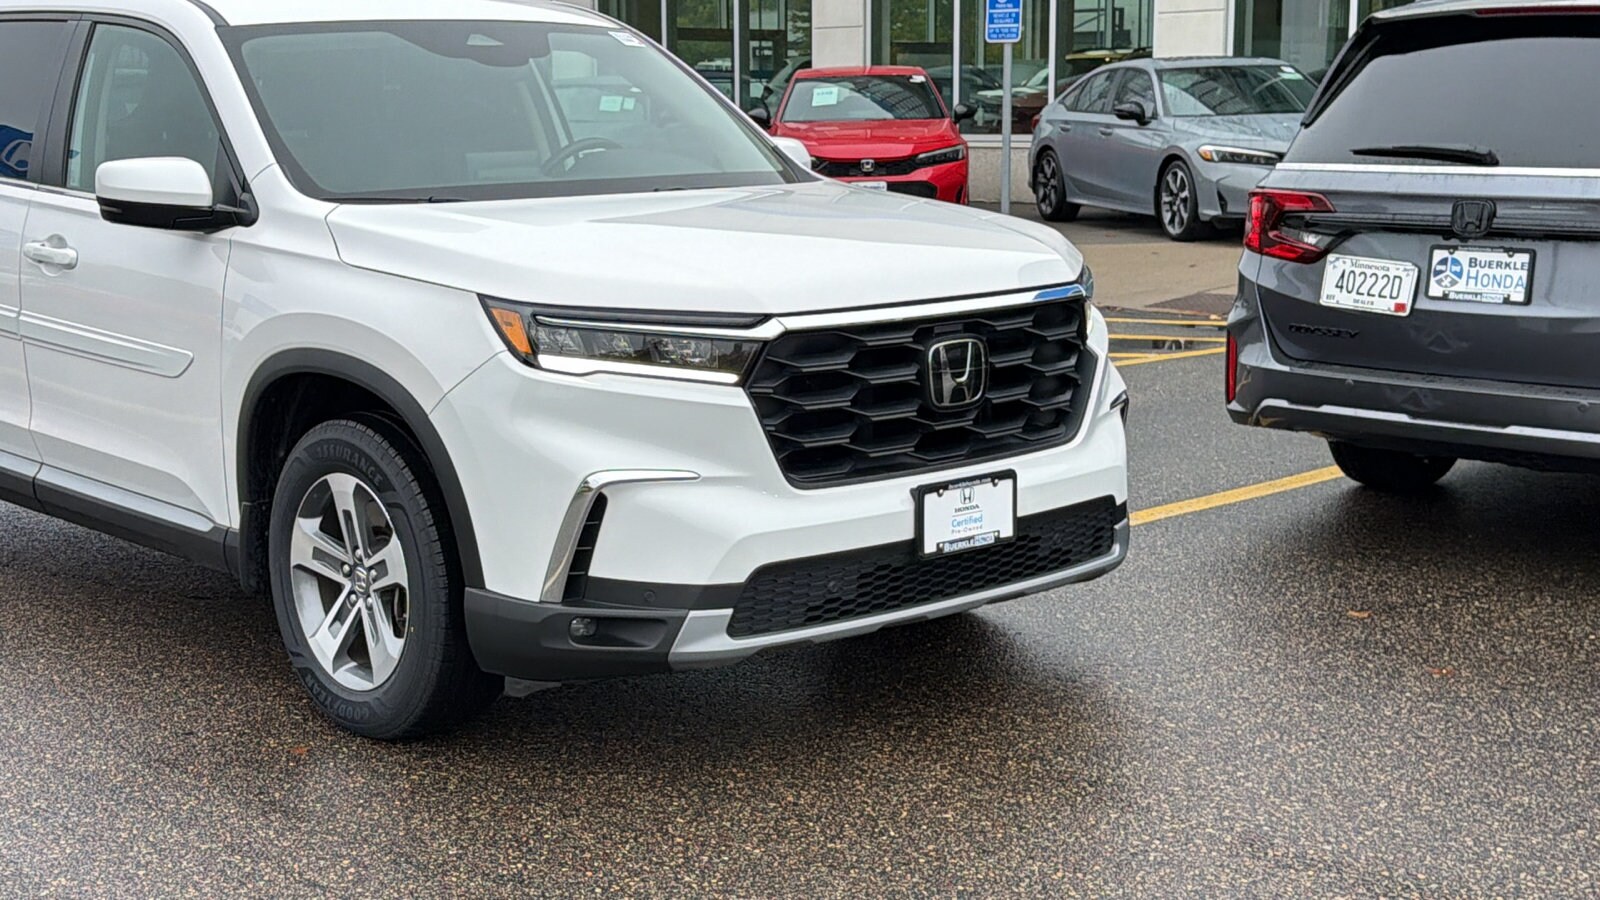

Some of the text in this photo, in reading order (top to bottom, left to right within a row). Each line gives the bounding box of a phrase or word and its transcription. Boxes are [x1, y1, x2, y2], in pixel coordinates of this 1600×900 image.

[1350, 258, 1390, 272] Minnesota
[1468, 257, 1529, 271] BUERKLE
[1335, 269, 1403, 300] 40222D
[1466, 269, 1526, 289] HONDA
[954, 504, 980, 513] HONDA
[951, 514, 983, 528] Certified
